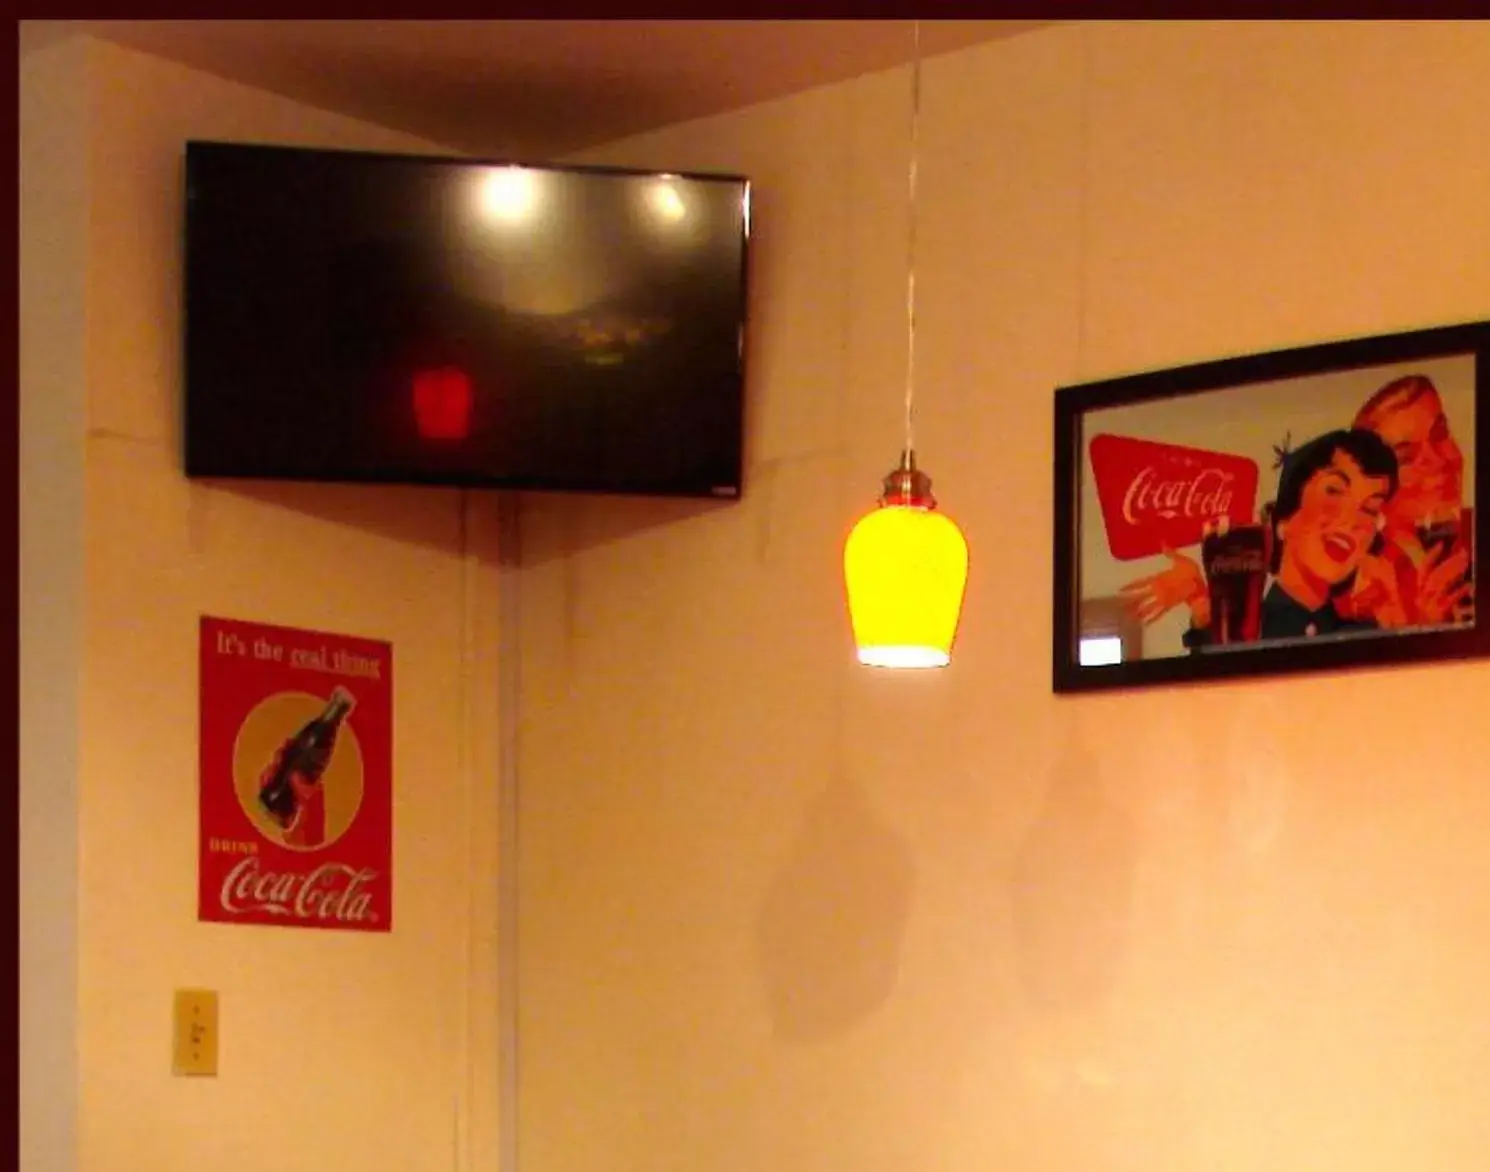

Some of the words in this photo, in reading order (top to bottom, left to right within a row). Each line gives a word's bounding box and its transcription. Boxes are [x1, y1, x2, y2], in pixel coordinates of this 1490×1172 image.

[216, 629, 247, 656] It's
[253, 636, 284, 663] the
[289, 644, 328, 670] real
[332, 648, 382, 680] thing
